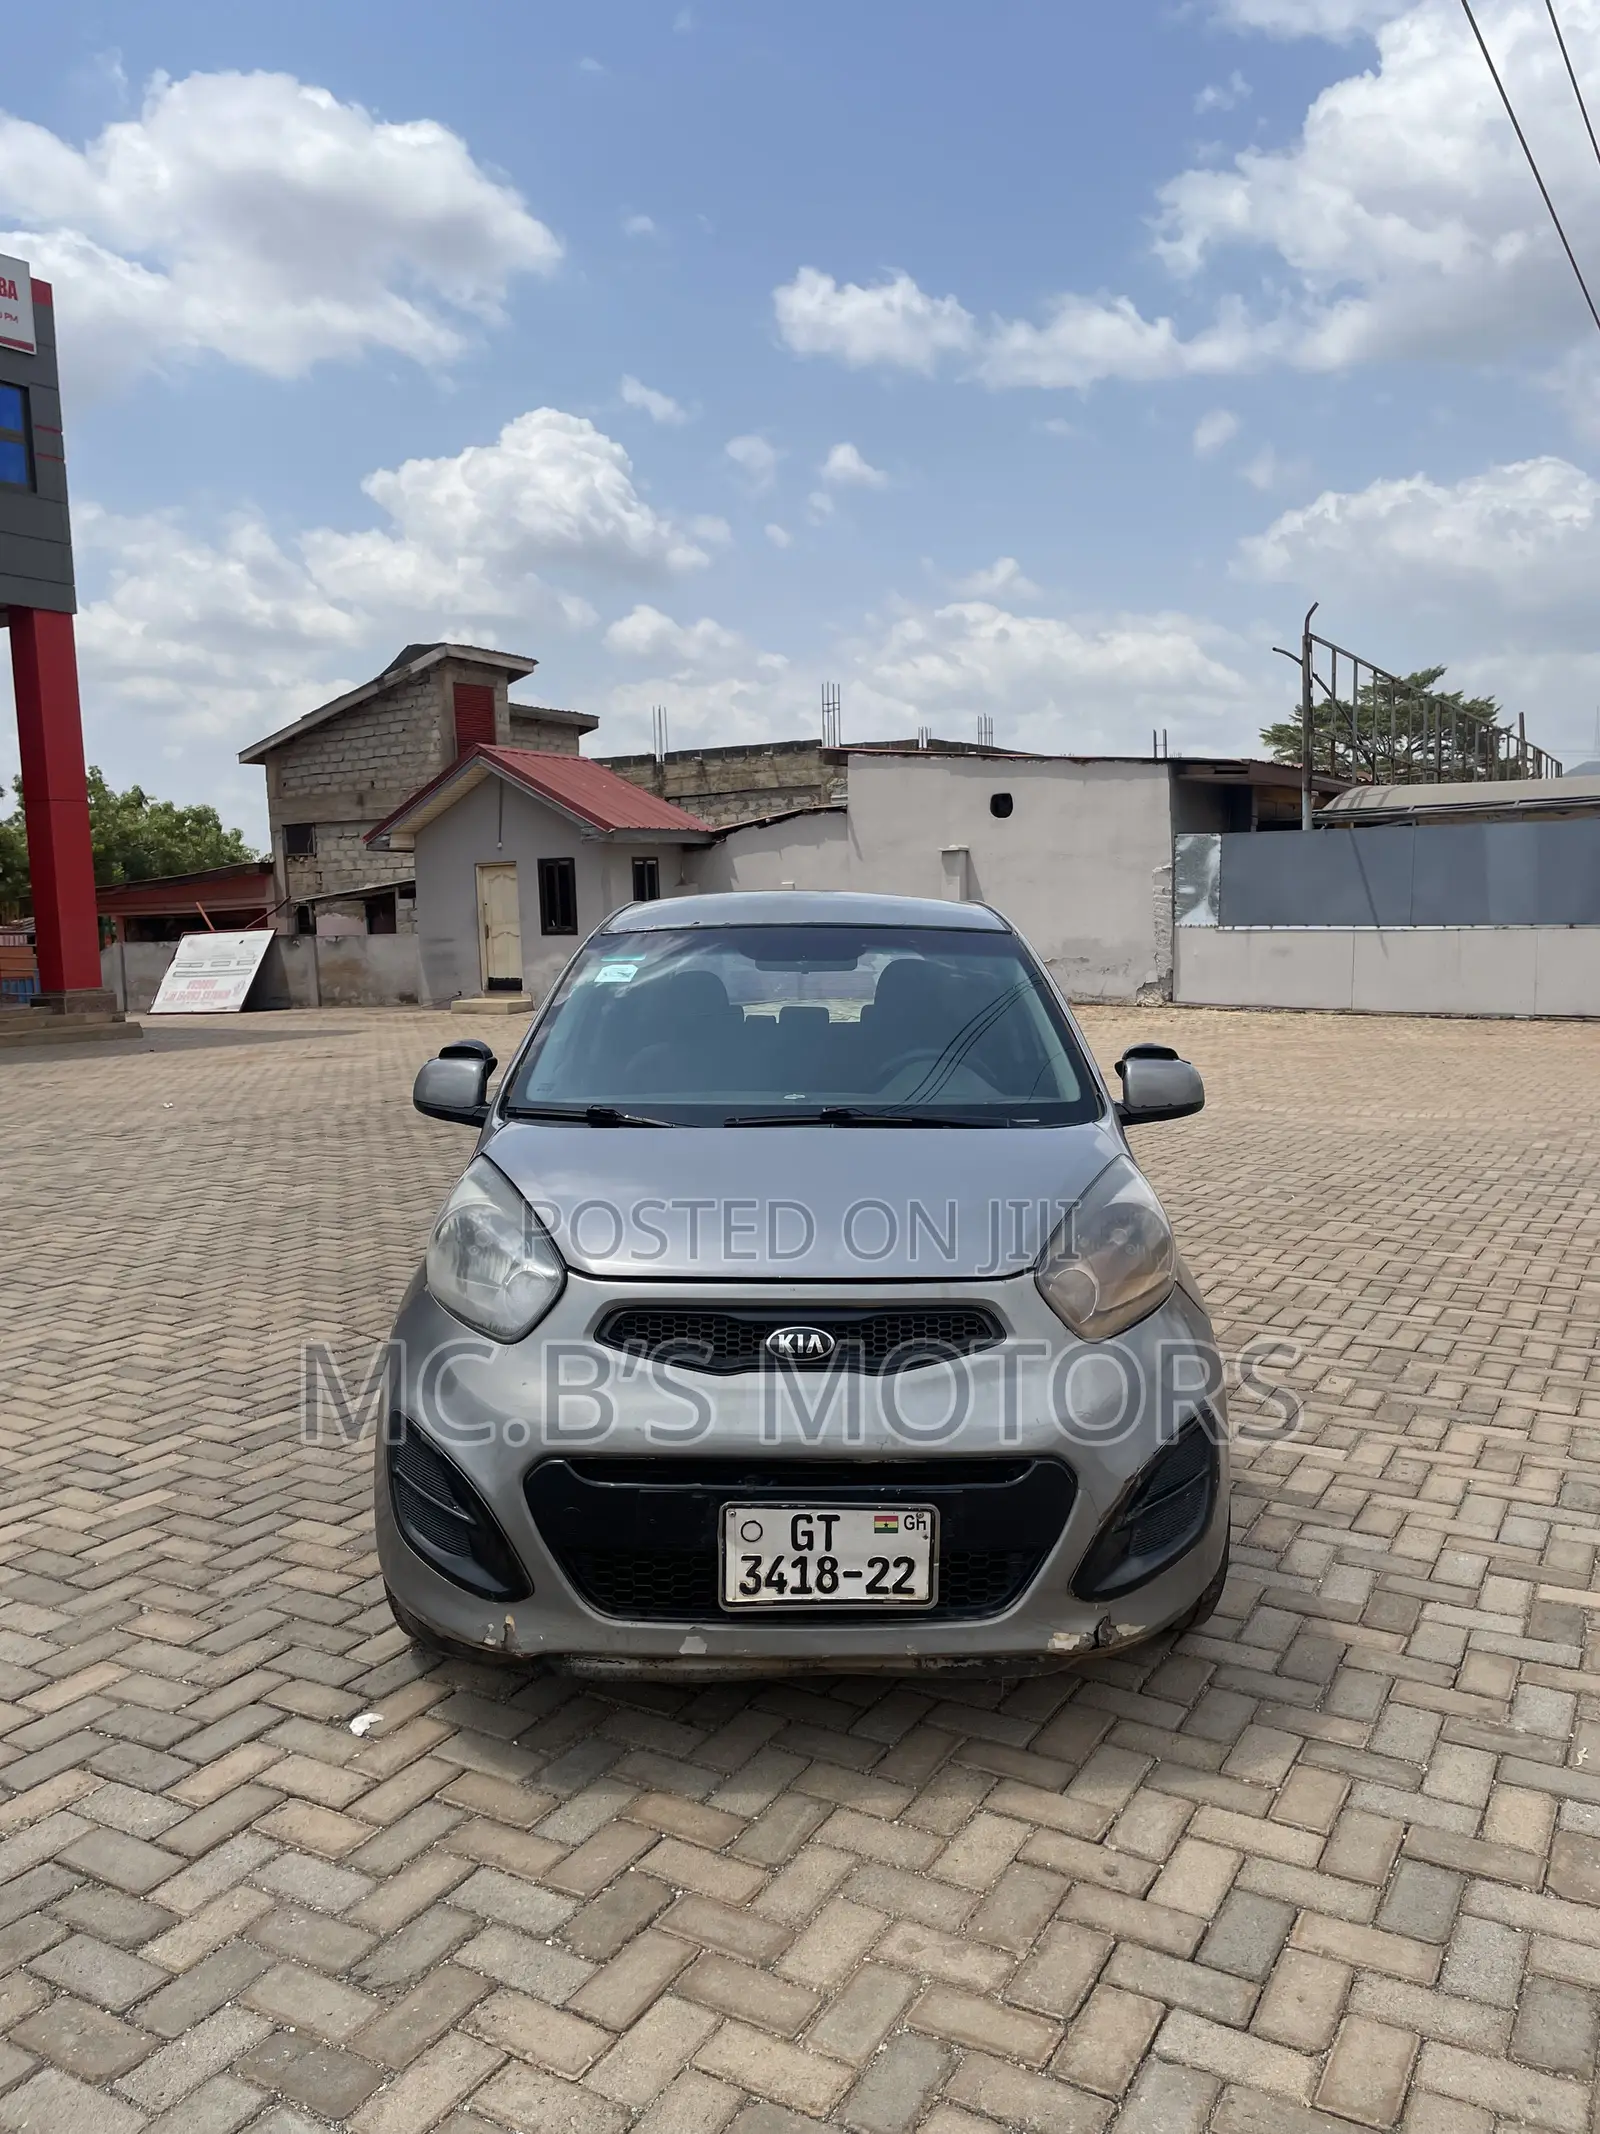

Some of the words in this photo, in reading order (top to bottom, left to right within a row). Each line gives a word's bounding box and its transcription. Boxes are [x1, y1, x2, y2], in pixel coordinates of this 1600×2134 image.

[777, 1333, 825, 1354] KIA
[790, 1514, 841, 1552] GT
[739, 1554, 916, 1595] 3418-22
